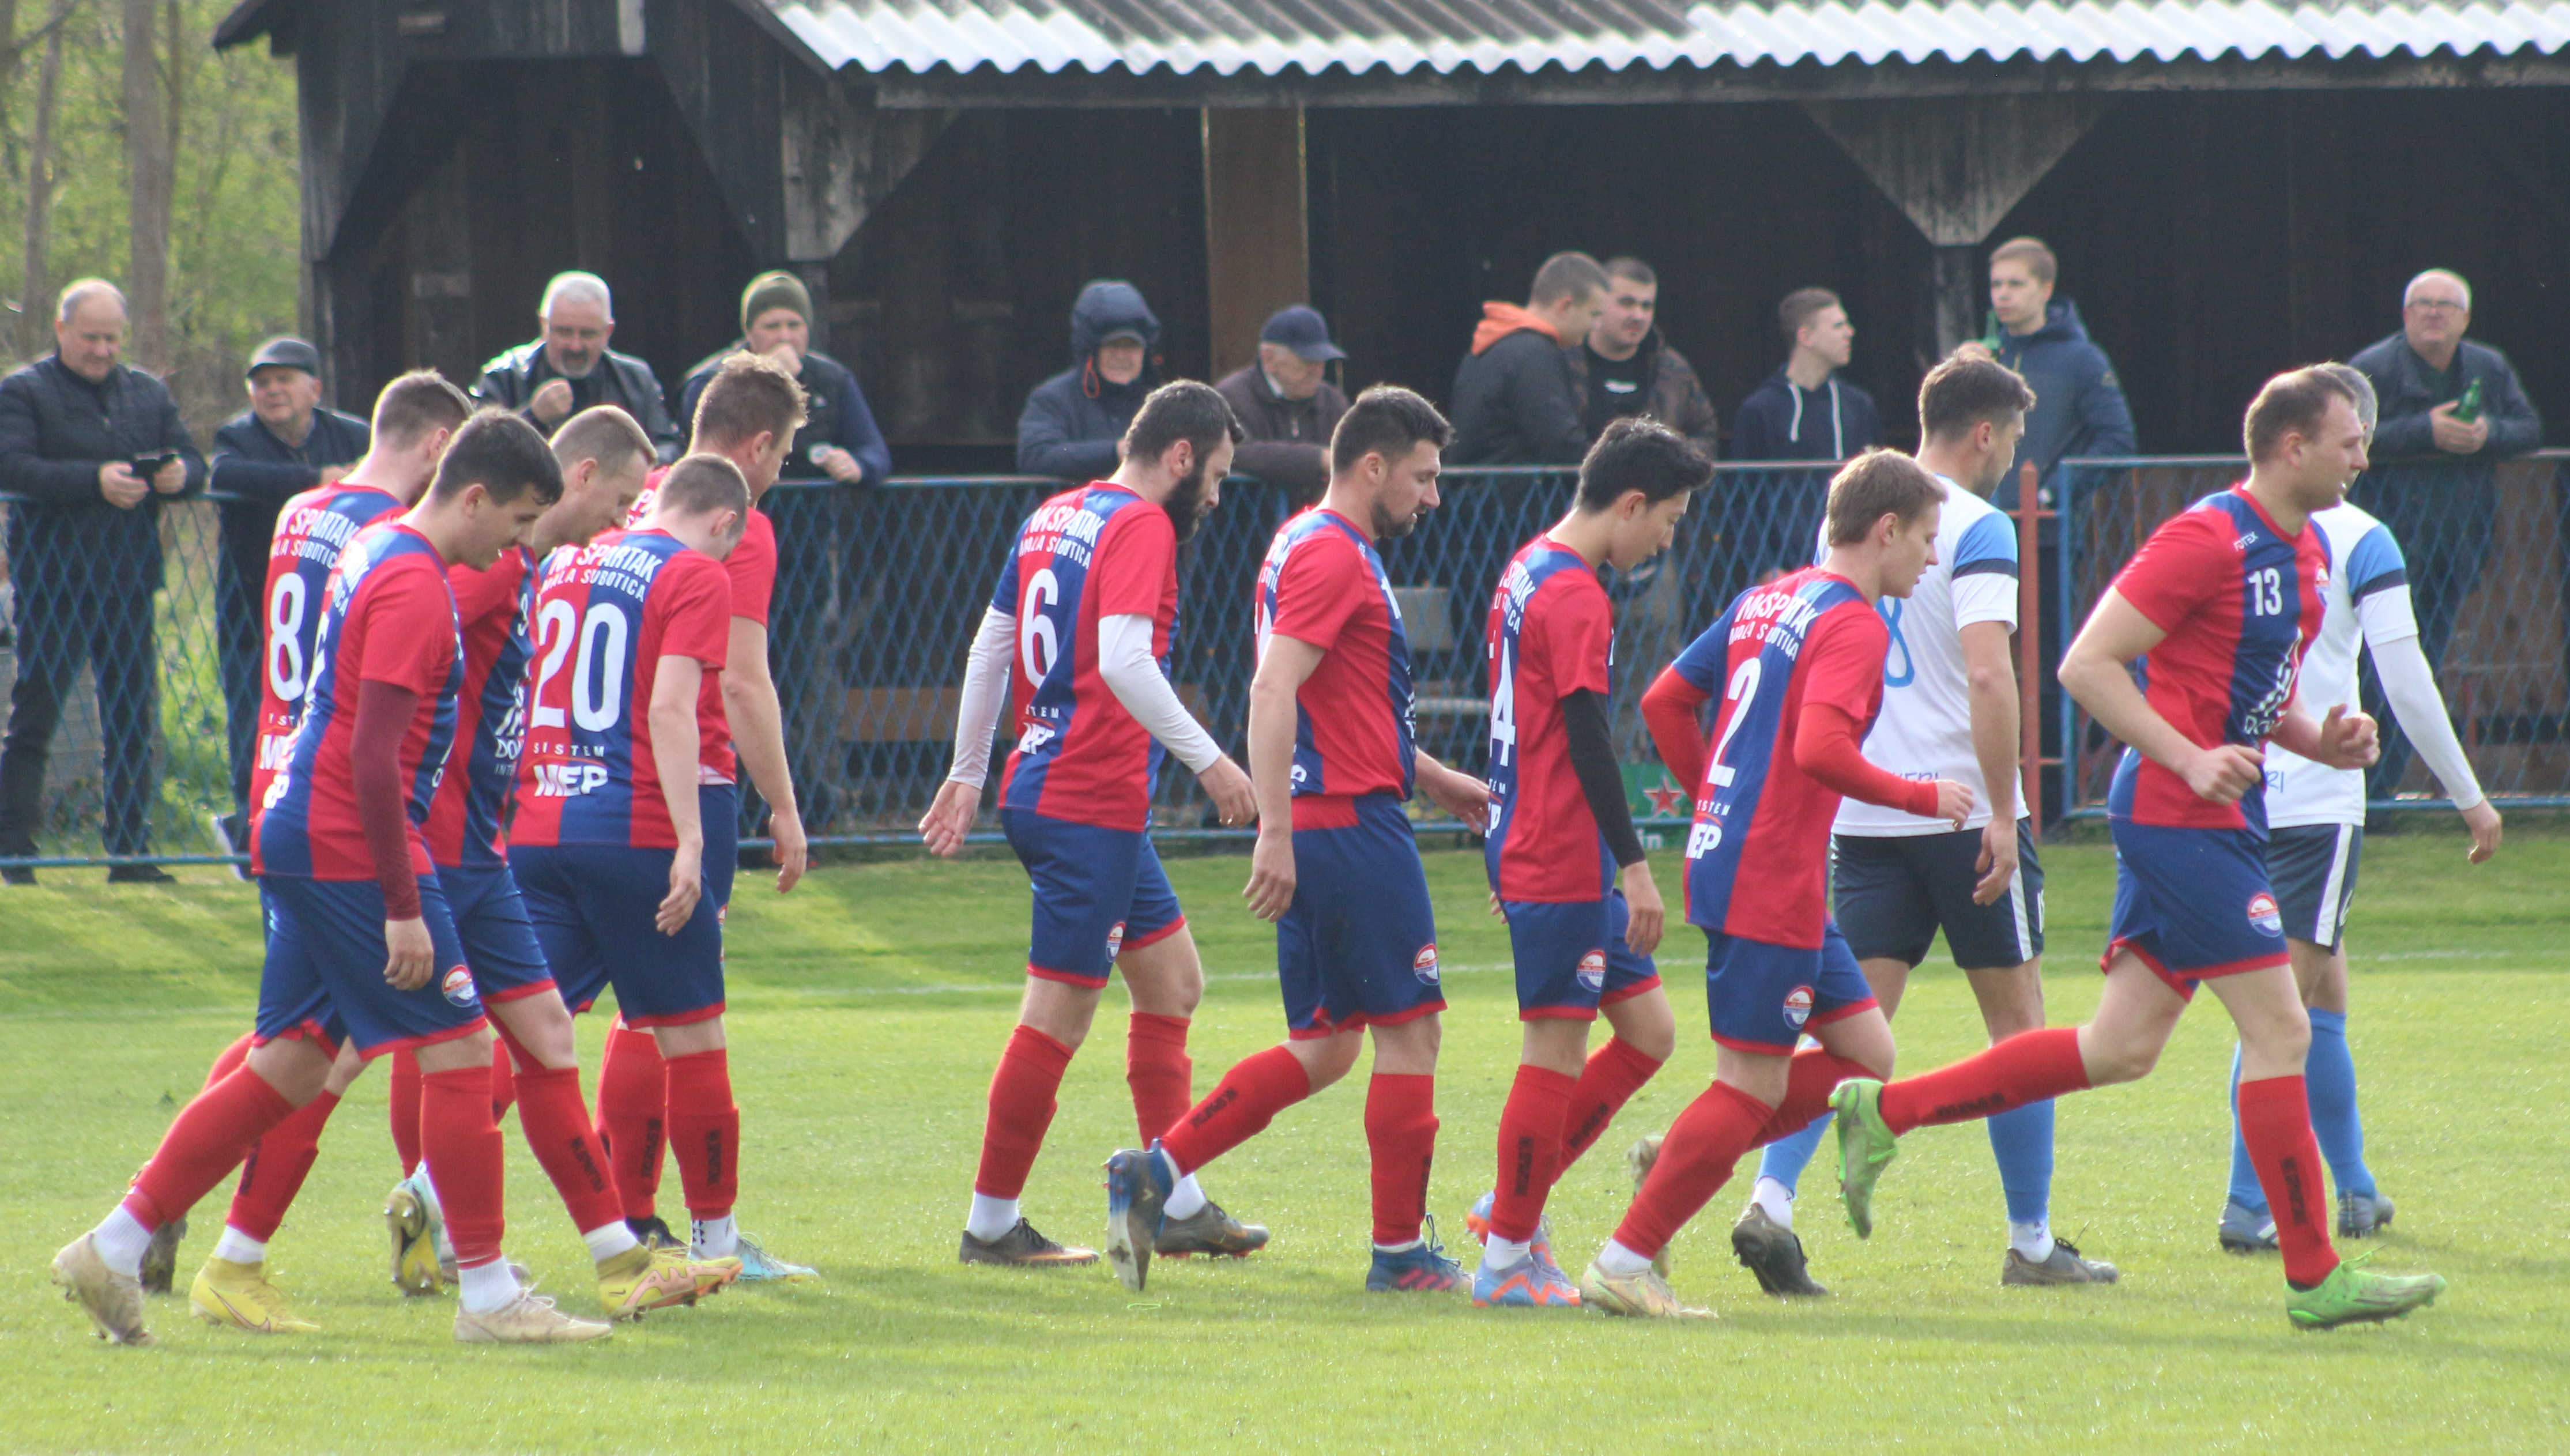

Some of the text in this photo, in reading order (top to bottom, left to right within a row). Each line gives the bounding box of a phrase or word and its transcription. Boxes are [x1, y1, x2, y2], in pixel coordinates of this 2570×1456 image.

[576, 543, 663, 583] SPARTAK
[580, 568, 646, 602] SUBOTICA
[2248, 567, 2283, 616] 13
[270, 572, 305, 702] 8
[1022, 568, 1059, 690] 6
[531, 598, 628, 733] 20
[1707, 657, 1762, 788] 2
[533, 741, 605, 757] SISTEM
[533, 764, 609, 797] MEP
